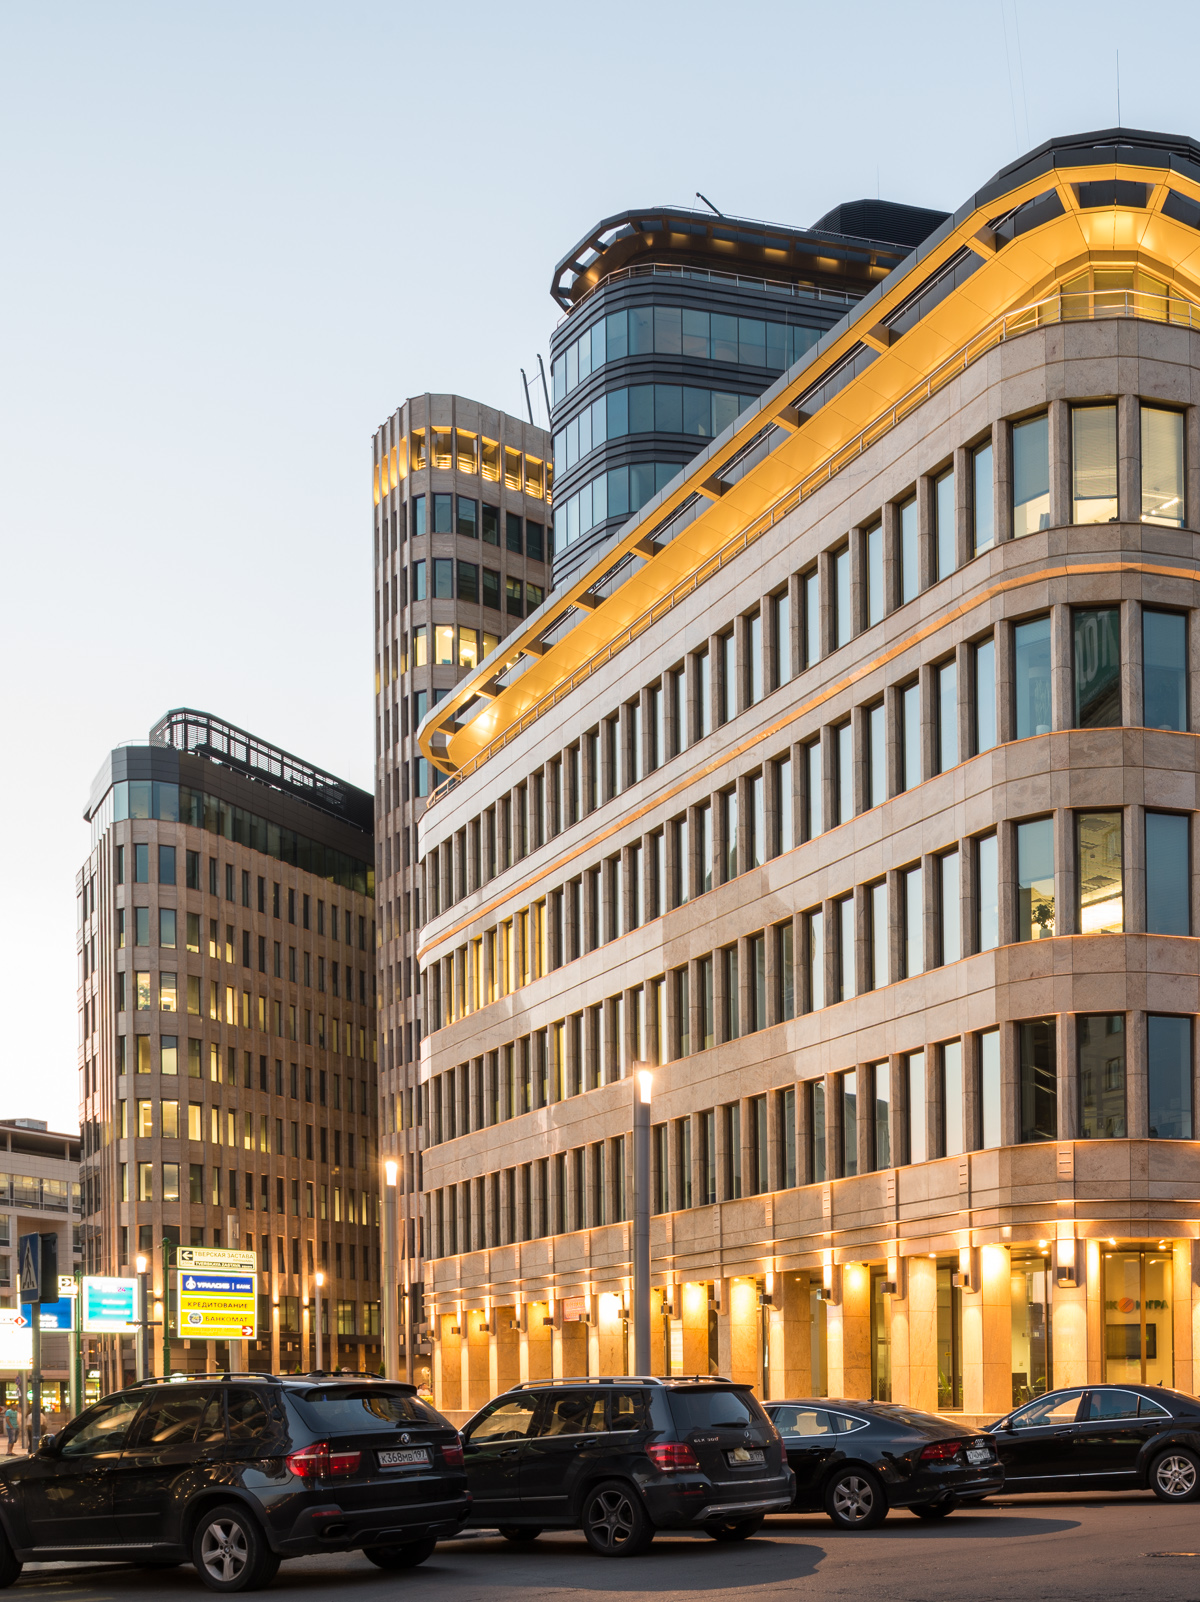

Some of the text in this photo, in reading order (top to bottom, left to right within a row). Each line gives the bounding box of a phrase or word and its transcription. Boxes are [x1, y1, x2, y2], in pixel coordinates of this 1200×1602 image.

[227, 1252, 254, 1260] ЗАСТАВА
[197, 1281, 230, 1289] УРАЛСИБ
[187, 1301, 248, 1309] КРЕДИТОВАНИЕ
[381, 1450, 425, 1463] К368МВ 197
